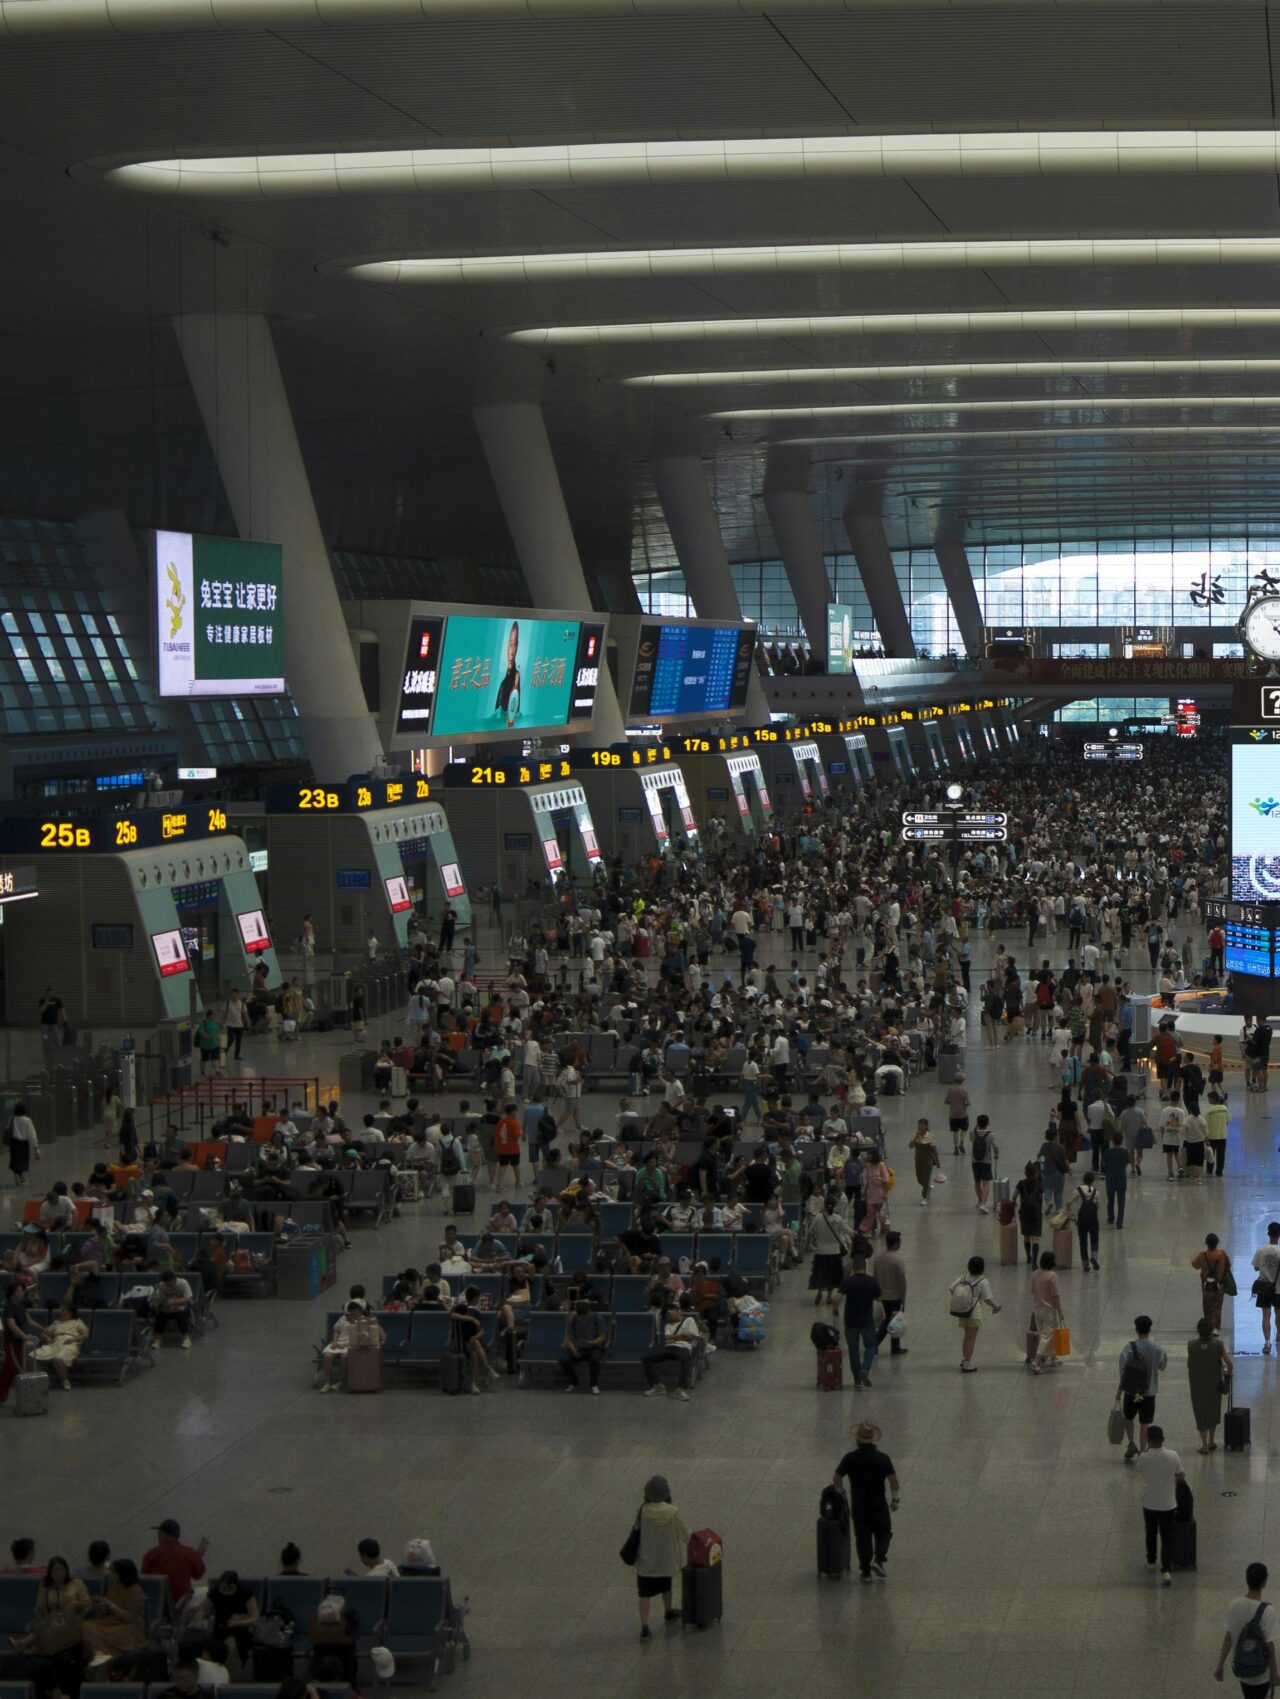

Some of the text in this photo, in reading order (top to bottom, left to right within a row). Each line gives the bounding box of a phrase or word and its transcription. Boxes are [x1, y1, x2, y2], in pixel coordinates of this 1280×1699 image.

[200, 578, 277, 611] 兔宝宝 让家更好
[206, 624, 273, 644] 专注健康家居板材
[901, 711, 913, 720] 9B
[932, 706, 944, 715] 7B
[811, 722, 832, 733] 13B
[857, 716, 876, 726] 11B
[683, 738, 710, 752] 17B
[754, 730, 777, 742] 15B
[591, 751, 621, 766] 19B
[472, 766, 506, 784] 21B
[358, 788, 372, 807] 23B
[416, 780, 429, 798] 22B
[298, 789, 340, 809] 23B
[208, 809, 227, 831] 24B
[40, 823, 91, 847] 25B
[116, 821, 138, 845] 25B
